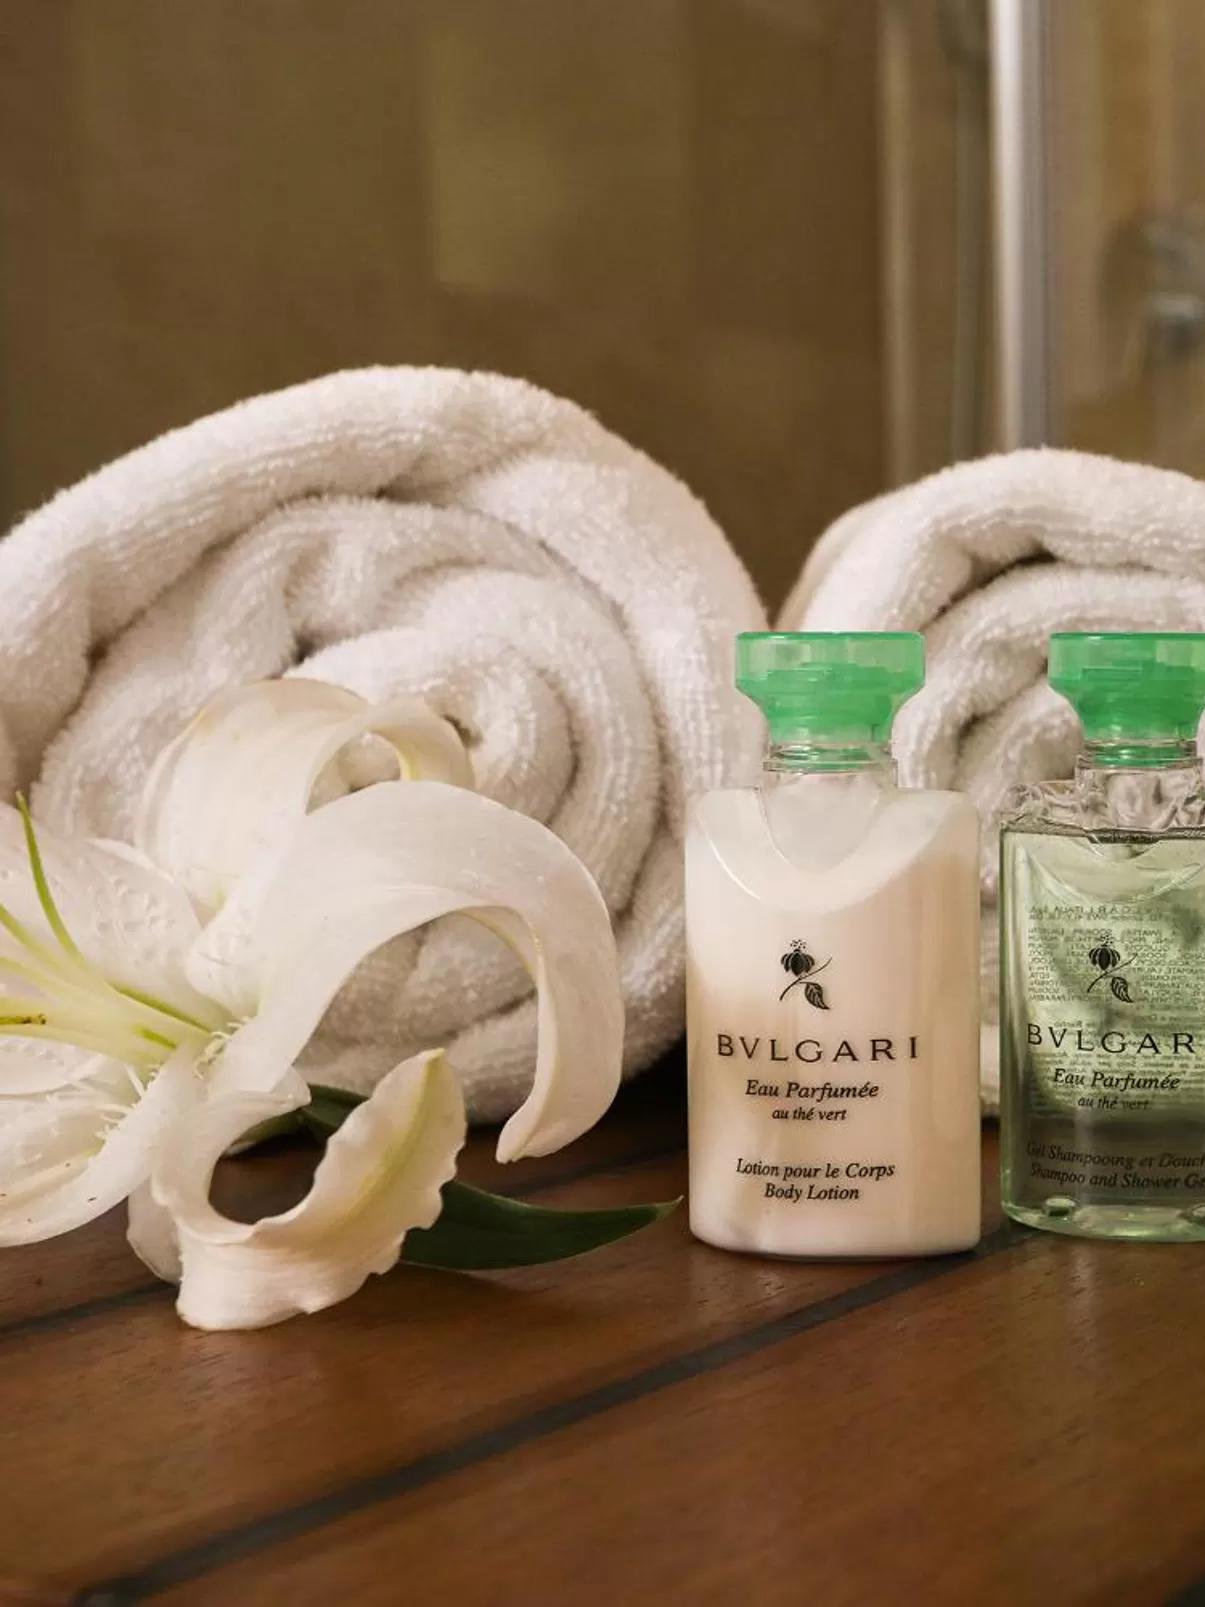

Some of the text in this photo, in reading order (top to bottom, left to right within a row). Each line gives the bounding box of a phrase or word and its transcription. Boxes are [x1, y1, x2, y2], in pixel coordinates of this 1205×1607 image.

[717, 1033, 918, 1063] BVLGARI
[745, 1079, 879, 1102] Eau Parfumée
[1053, 1068, 1180, 1092] Eau Parfumée
[772, 1107, 847, 1121] au thé vert
[1077, 1096, 1149, 1110] au thé vert
[1027, 1141, 1046, 1156] Gel
[1049, 1145, 1134, 1170] Shampooing
[1138, 1156, 1154, 1167] et
[736, 1158, 895, 1181] Lotion pour le Corps
[1031, 1163, 1085, 1185] Shampoo
[1089, 1173, 1117, 1187] and
[1121, 1173, 1180, 1189] Shower
[764, 1183, 859, 1203] Body Lotion
